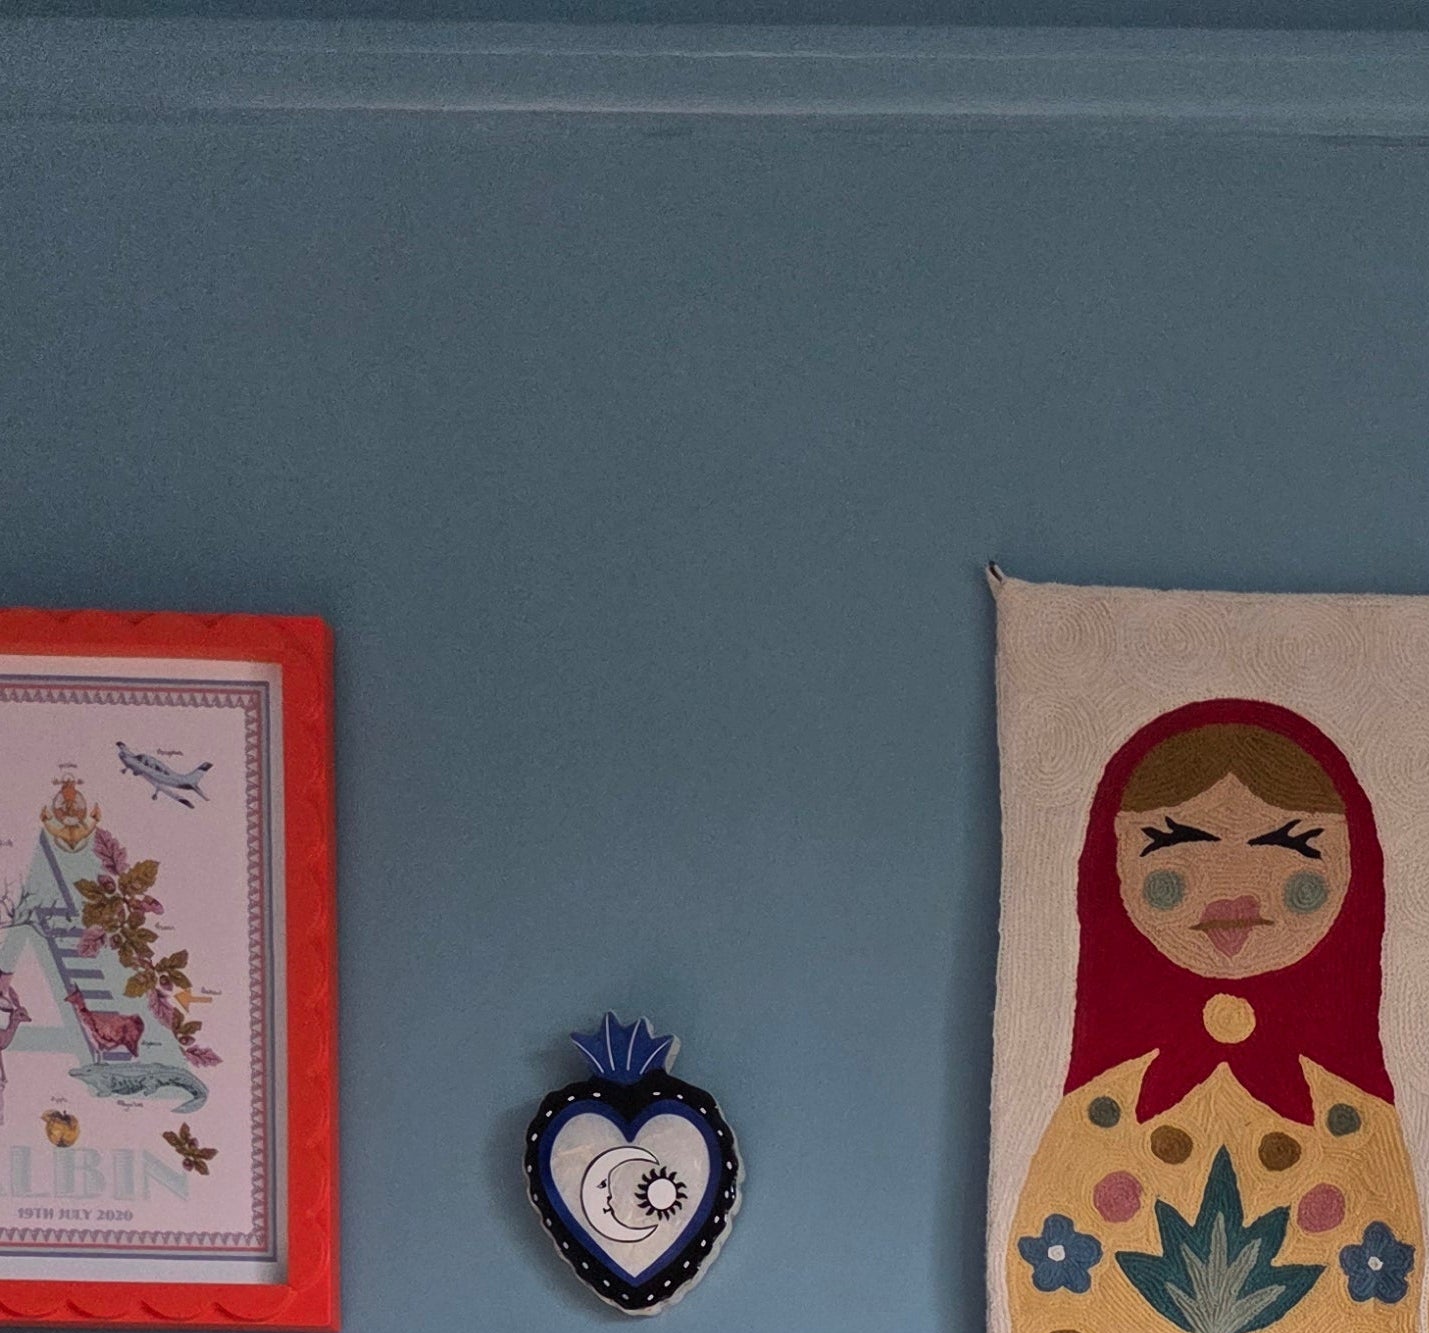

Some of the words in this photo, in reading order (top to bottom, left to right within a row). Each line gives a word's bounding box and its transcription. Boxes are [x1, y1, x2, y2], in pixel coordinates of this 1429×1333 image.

[0, 1147, 190, 1201] LBIN
[17, 1207, 53, 1219] 19TH
[98, 1209, 134, 1221] 2020
